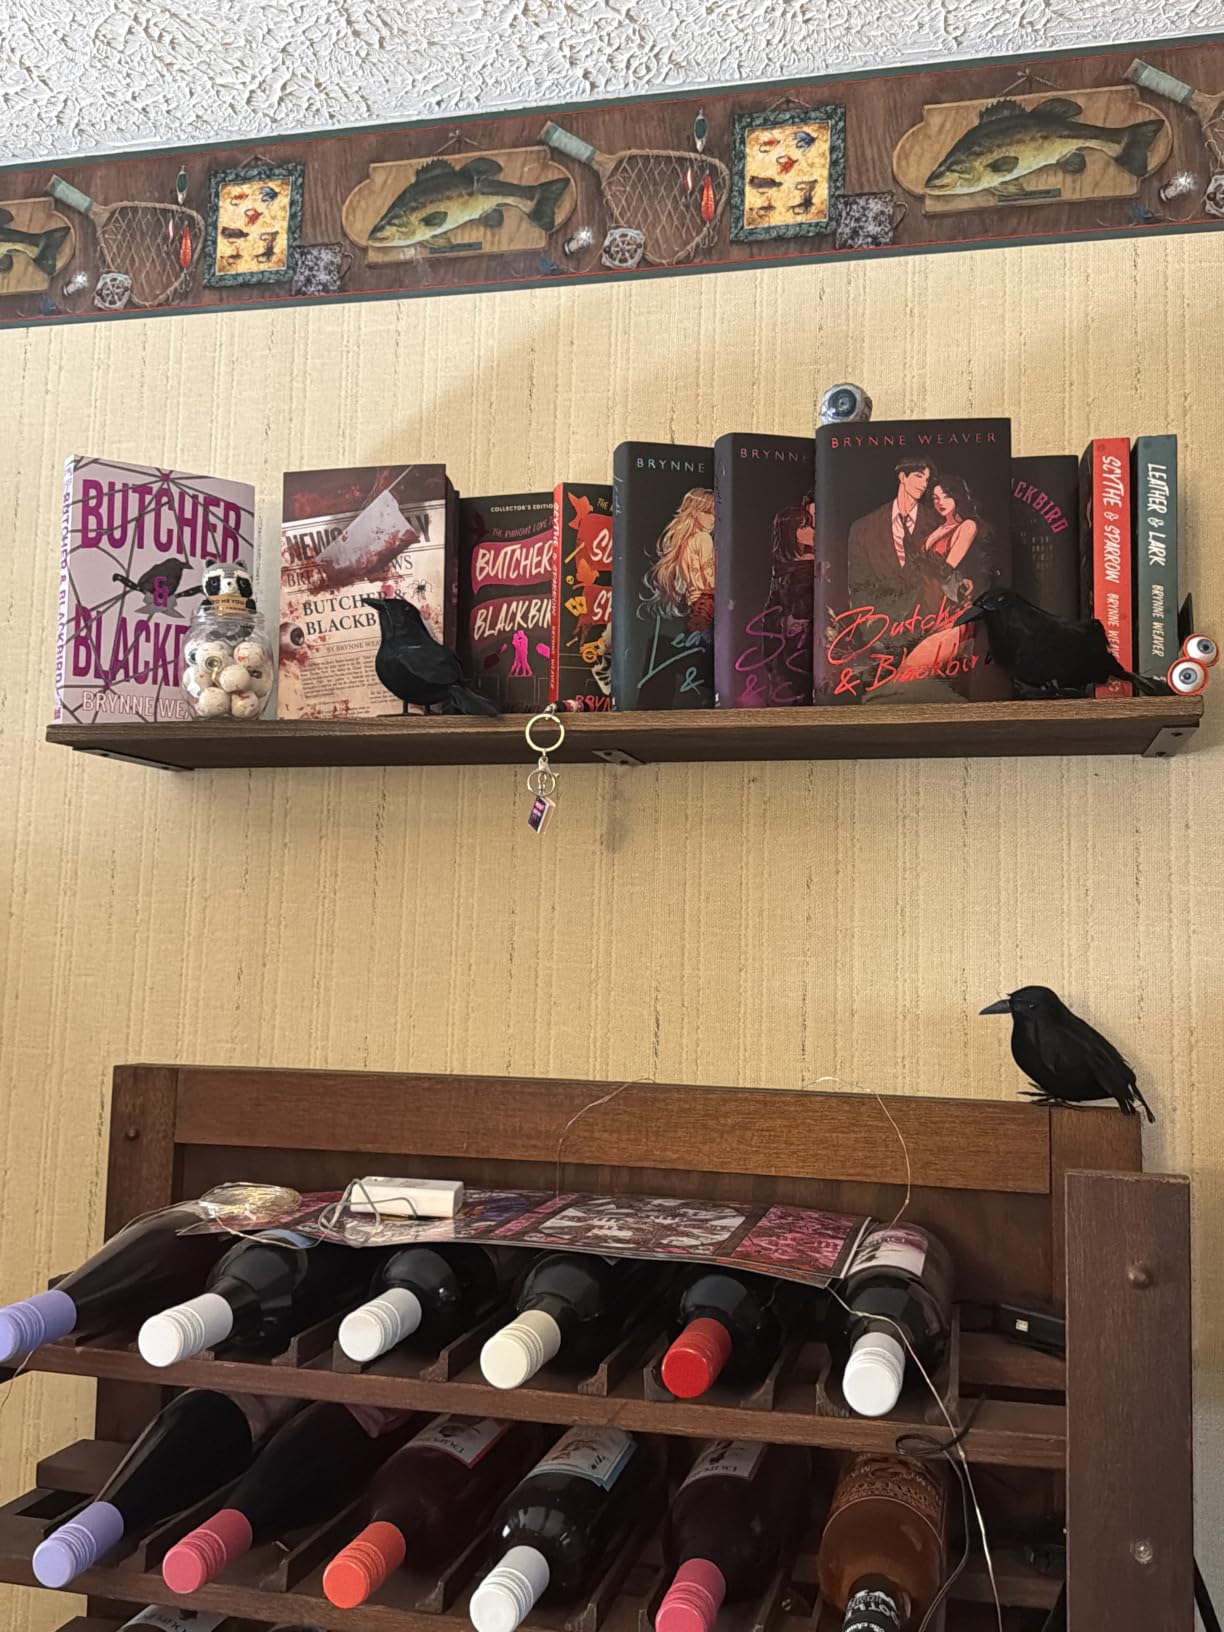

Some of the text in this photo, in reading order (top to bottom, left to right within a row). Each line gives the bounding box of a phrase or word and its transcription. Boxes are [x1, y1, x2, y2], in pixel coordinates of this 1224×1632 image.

[739, 448, 809, 464] BRYNNE
[831, 432, 997, 449] BRYNNE WEAVER
[636, 458, 706, 473] BRYNNE
[1102, 455, 1125, 508] SCYTHE
[1147, 463, 1170, 514] LEATHER
[80, 479, 242, 562] BUTCHER
[490, 504, 532, 513] COLLECTOR'S
[1012, 480, 1069, 533] CKBIRD
[1103, 511, 1120, 521] &
[1147, 517, 1165, 528] &
[475, 540, 553, 582] BUTCHER
[1103, 525, 1122, 584] SPARROW
[1148, 531, 1167, 567] LARK
[153, 576, 169, 608] &
[1151, 584, 1165, 619] BRYNNE
[305, 612, 377, 636] BLACKB
[1106, 593, 1120, 628] BRYNNE
[326, 640, 380, 653] BY BRYNNE WEA
[1151, 621, 1165, 657] WEAVER
[679, 667, 704, 694] &
[834, 668, 861, 696] &
[865, 641, 986, 692] Blackbir
[83, 691, 153, 717] BRYNNE
